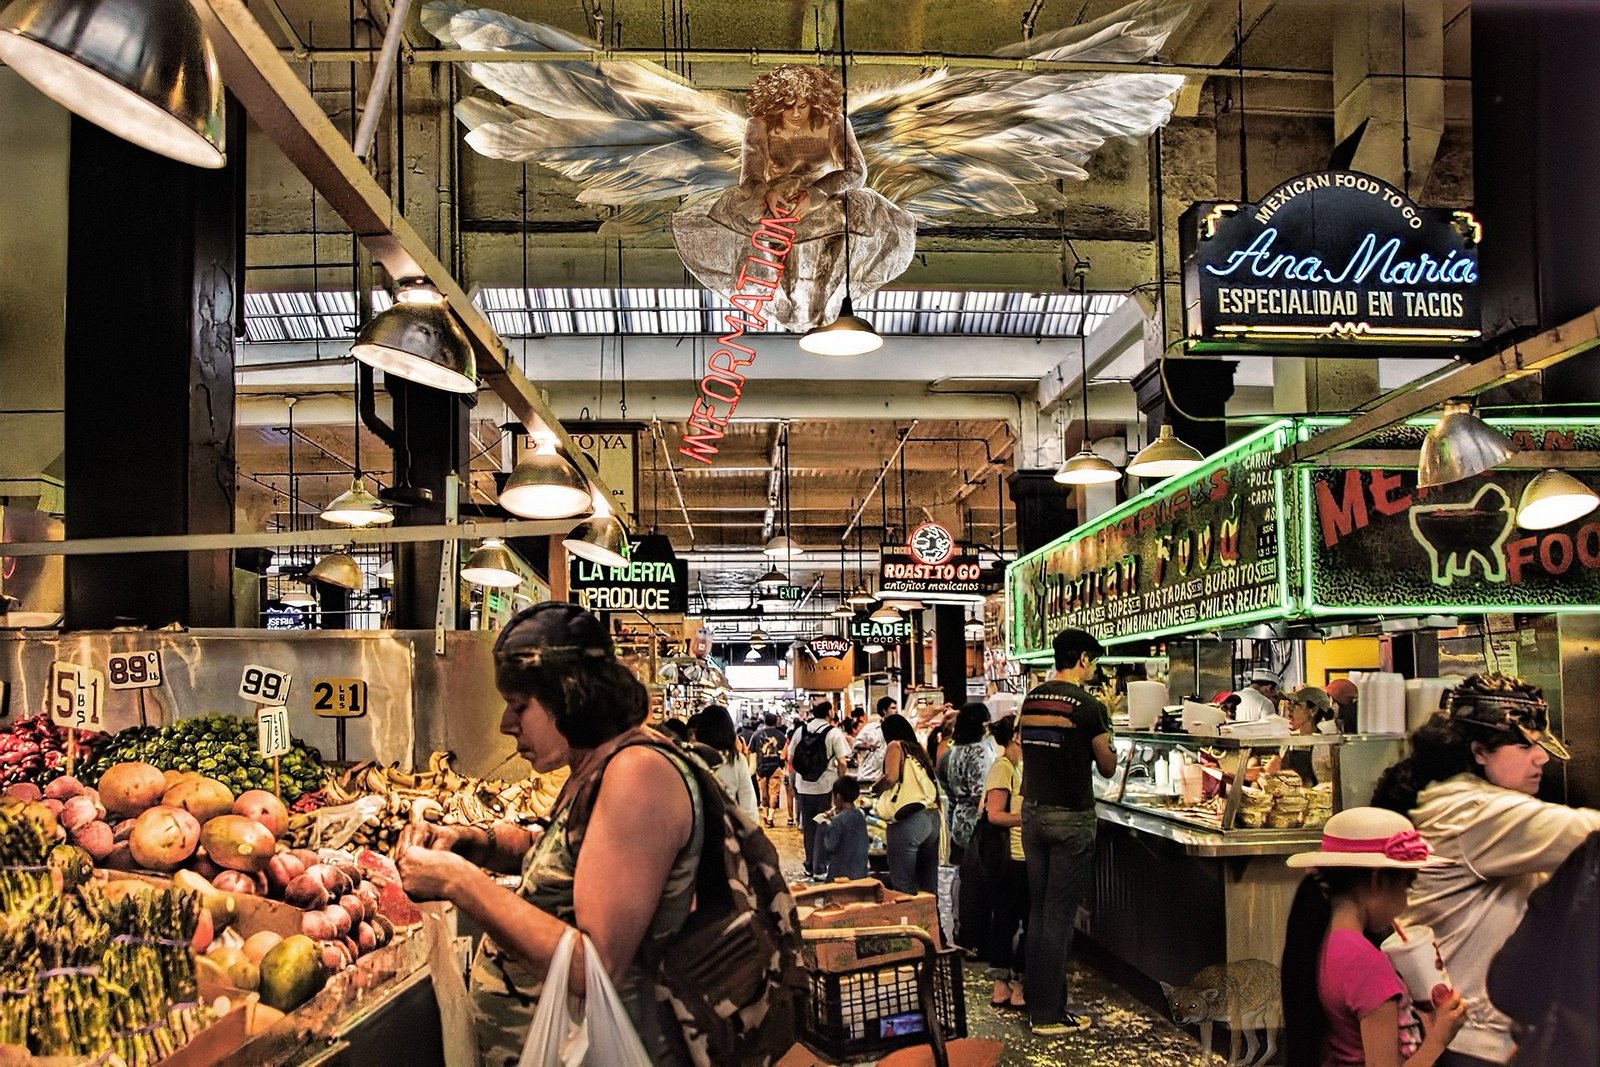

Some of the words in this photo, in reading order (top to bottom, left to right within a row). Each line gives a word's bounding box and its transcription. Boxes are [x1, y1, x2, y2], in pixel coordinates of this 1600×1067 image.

[1254, 174, 1331, 225] MEXICAN
[1335, 173, 1381, 195] FOOD
[1382, 187, 1404, 209] TO
[1400, 205, 1423, 230] GO
[1206, 228, 1322, 282] Ana
[1217, 287, 1358, 316] ESPECIALIDAD
[1368, 291, 1394, 317] EN
[1402, 292, 1464, 318] TACOS
[578, 561, 604, 582] LA
[883, 563, 932, 579] ROAST
[934, 564, 955, 580] TO
[956, 563, 981, 581] GO
[587, 588, 670, 610] PRODUCE
[779, 587, 800, 600] EXIT
[883, 580, 926, 592] antojitos
[927, 580, 980, 591] mexicanos
[1143, 580, 1193, 611] TOSTADAS
[1204, 562, 1261, 596] BURRITOS
[1116, 604, 1186, 637] COMBINACIONES
[1200, 592, 1235, 620] CHILES
[810, 639, 849, 652] TERIYAKI
[866, 636, 901, 645] FOODS
[56, 671, 75, 718] 5
[90, 678, 99, 724] 1
[313, 681, 334, 710] 2
[338, 684, 346, 709] LBS
[348, 683, 361, 712] 1
